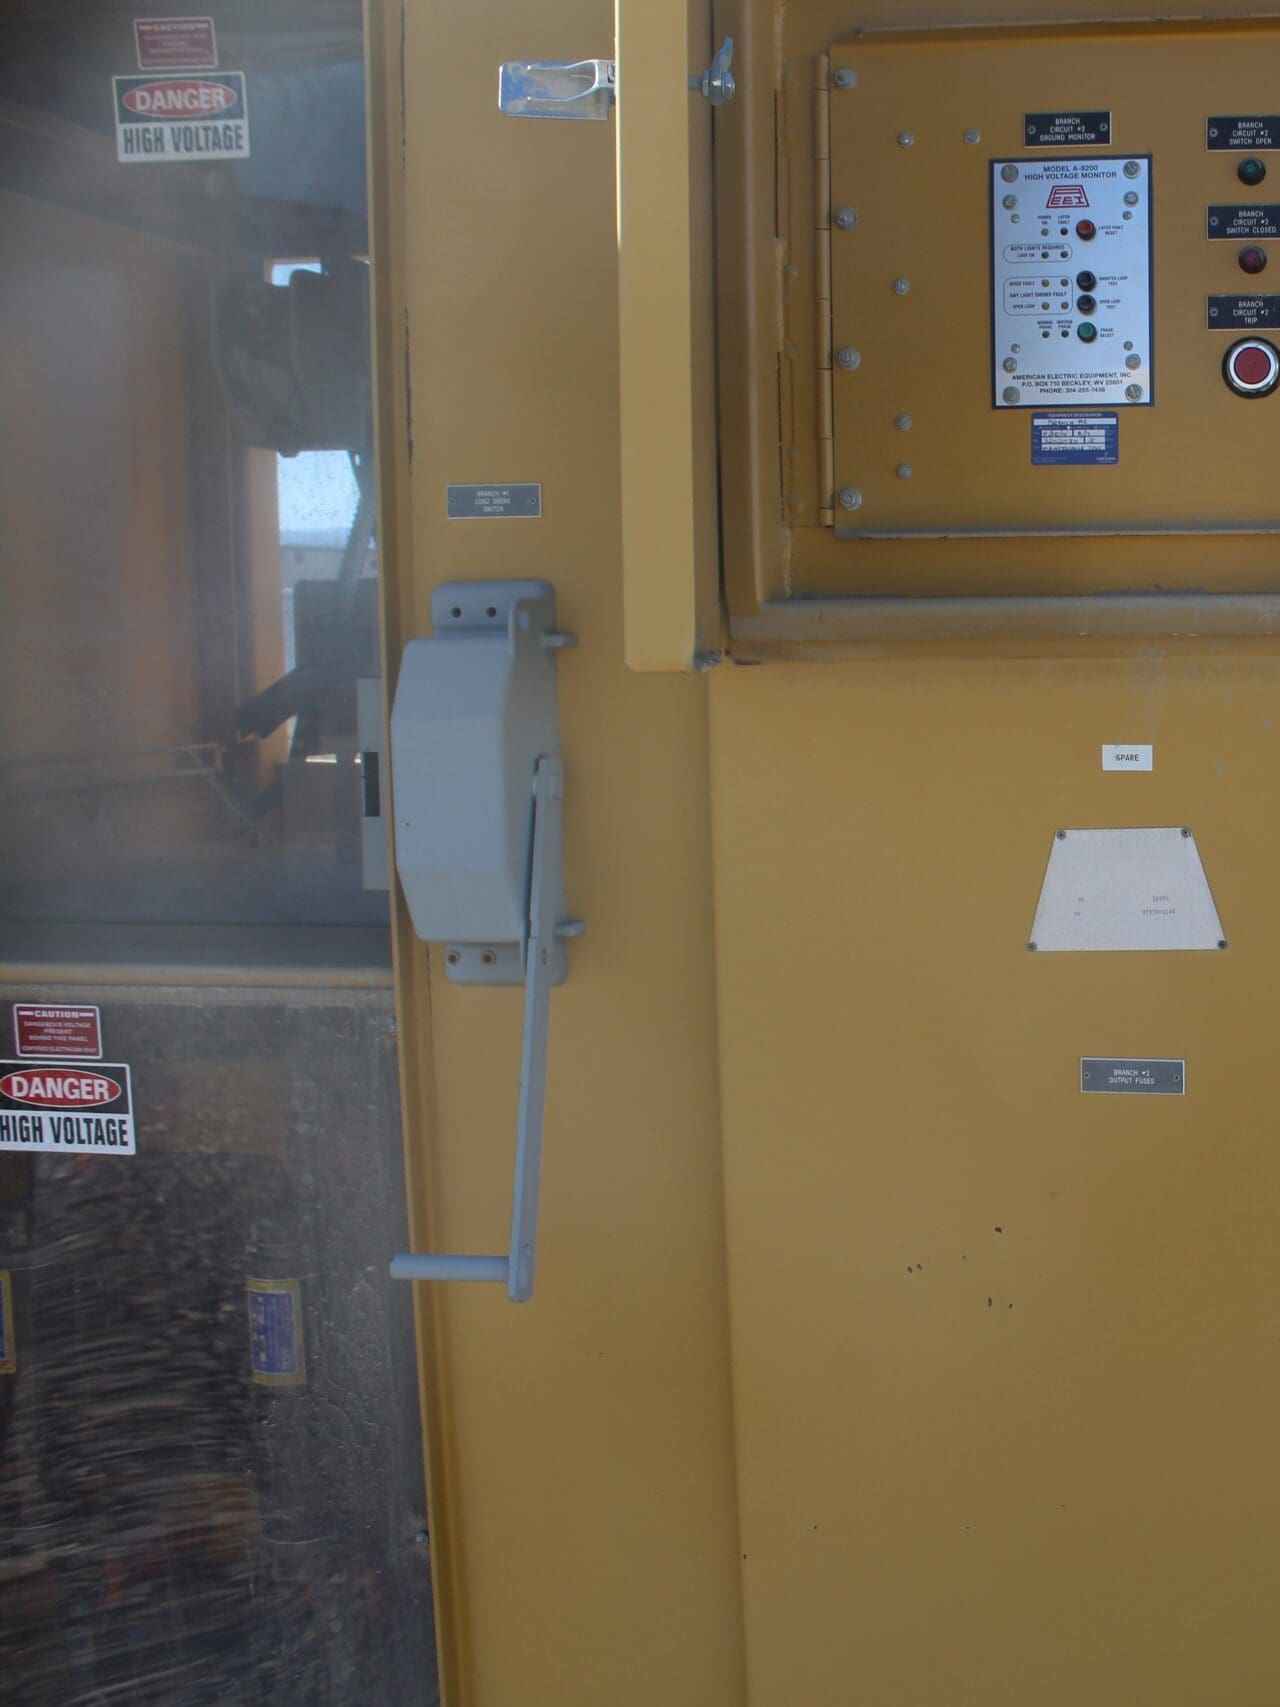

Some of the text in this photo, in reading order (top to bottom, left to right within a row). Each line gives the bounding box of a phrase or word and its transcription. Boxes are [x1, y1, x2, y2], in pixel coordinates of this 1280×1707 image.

[136, 88, 225, 110] DANGER
[123, 124, 244, 154] HIGH VOLTAGE
[1081, 171, 1117, 179] MONITOR
[11, 1076, 110, 1100] DANGER
[1109, 1076, 1132, 1084] OUTPUT
[0, 1115, 129, 1147] HIGH VOLTAGE
